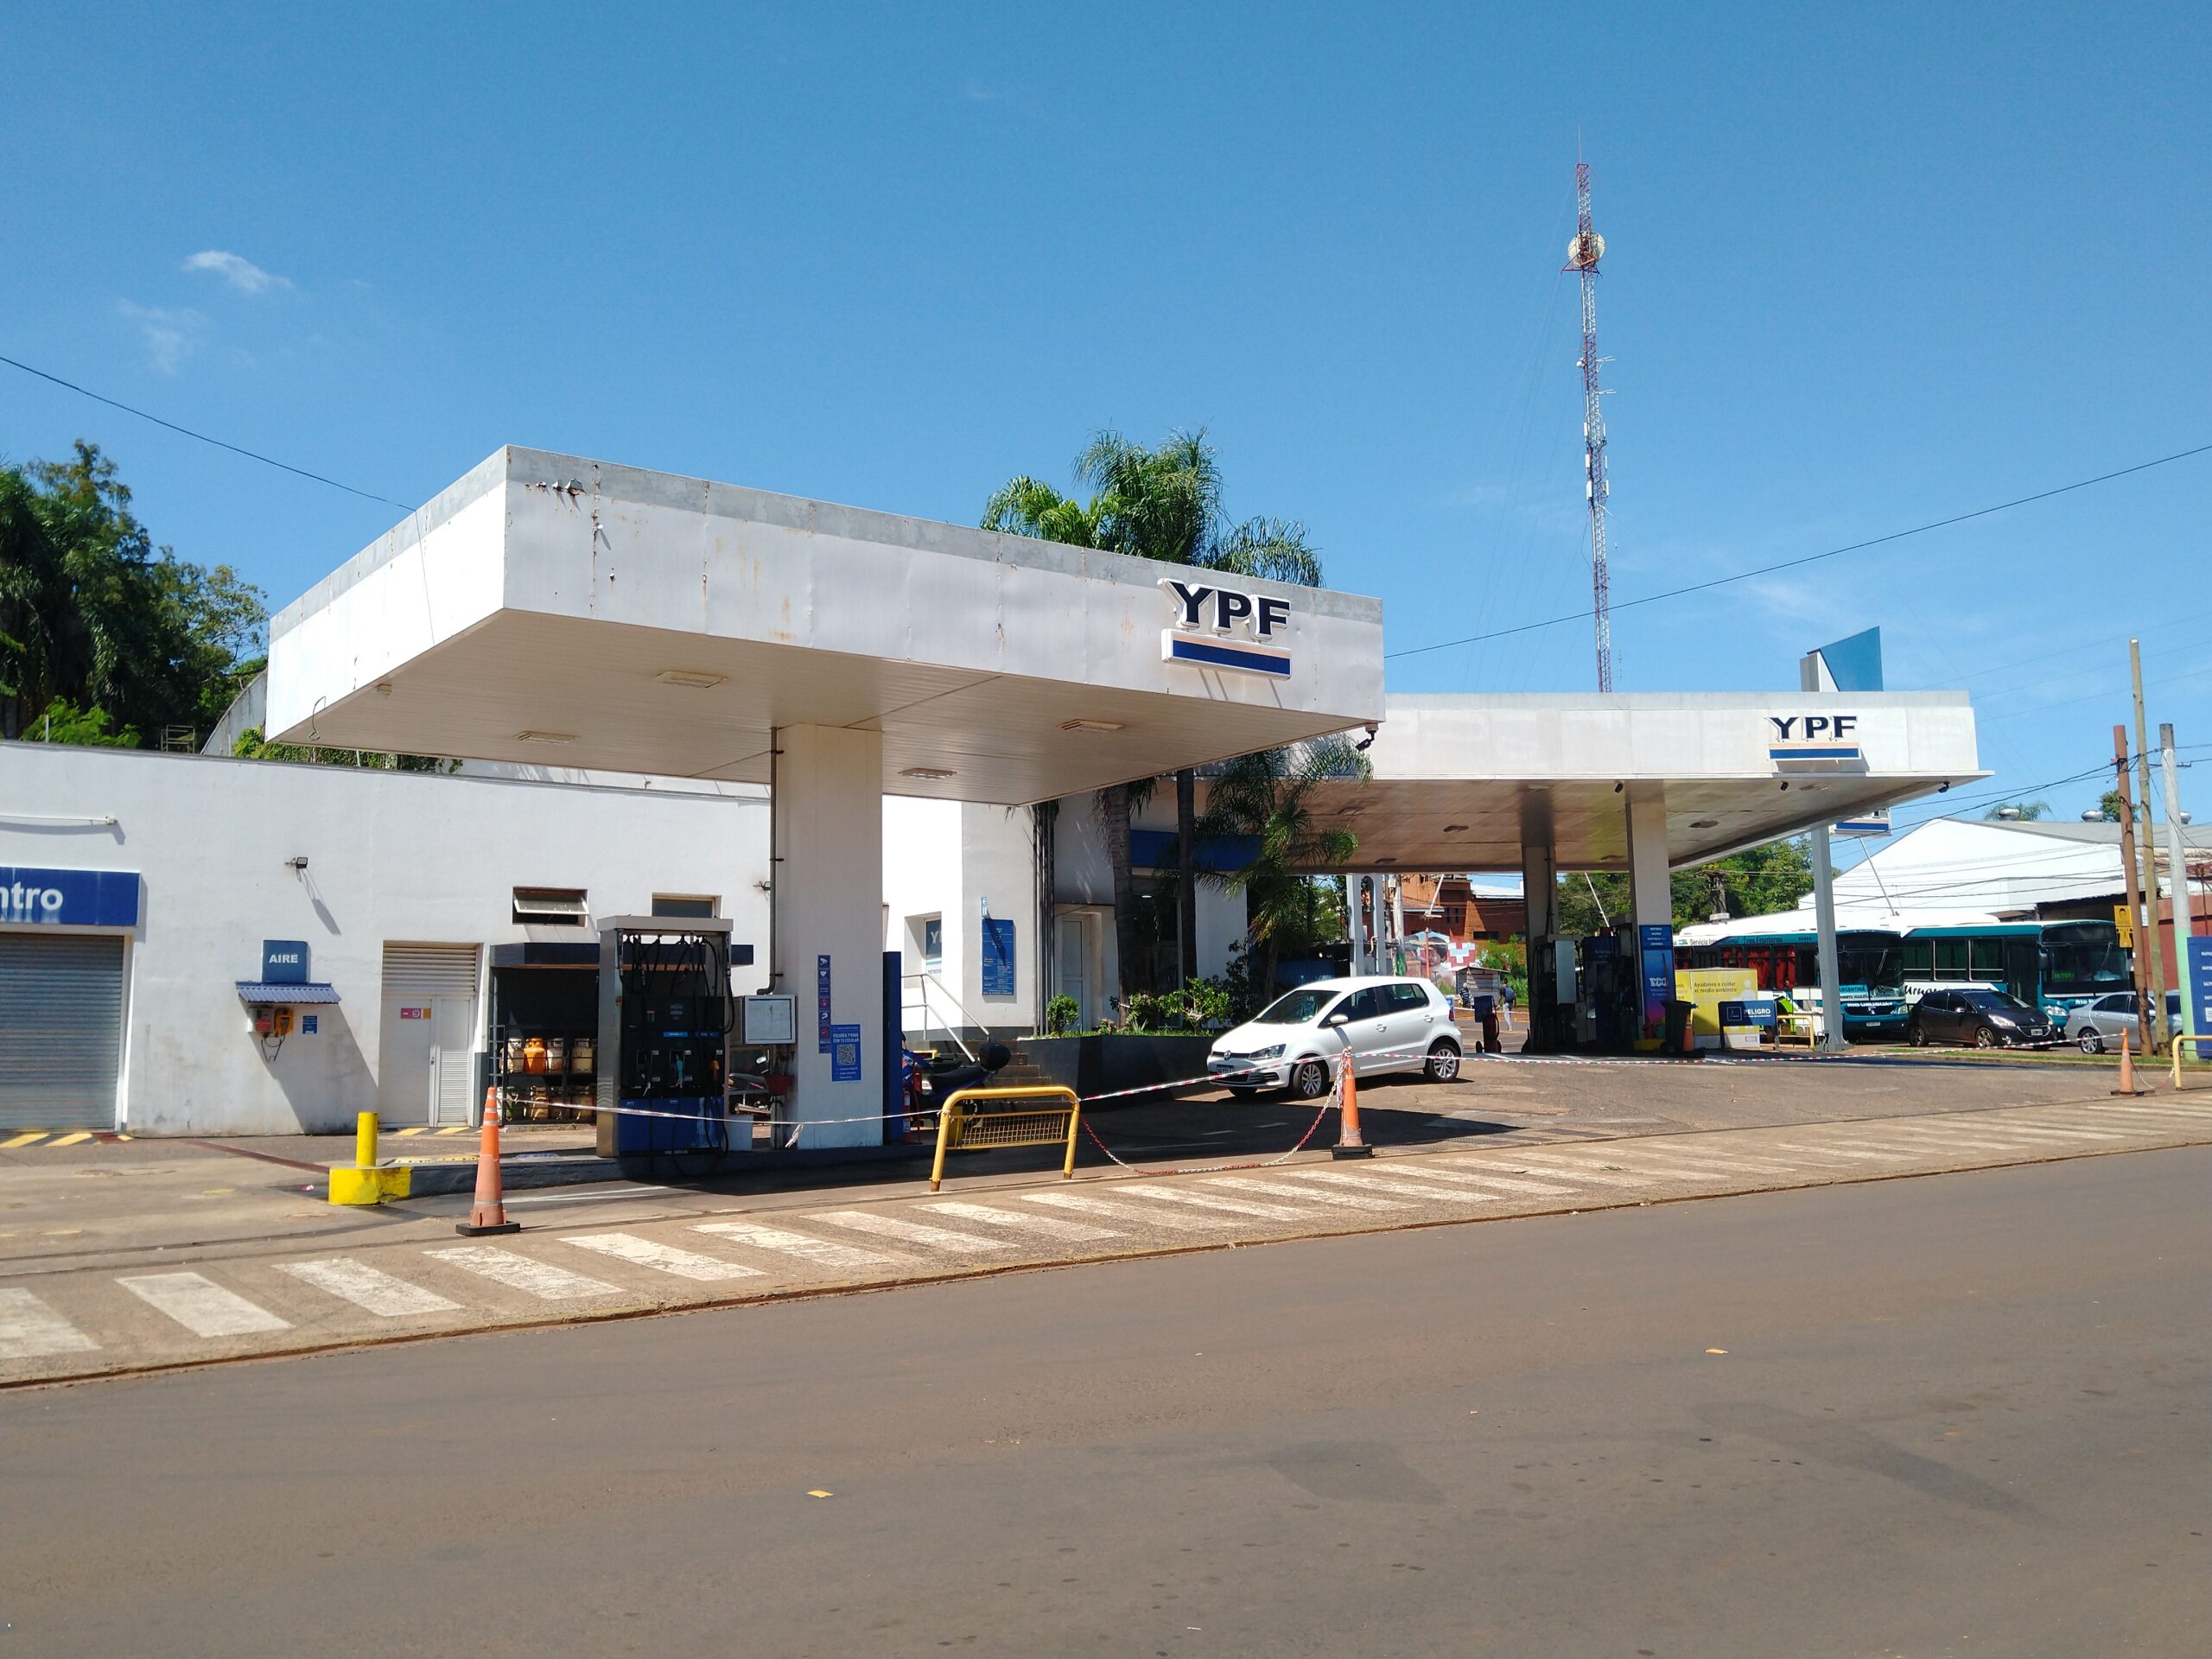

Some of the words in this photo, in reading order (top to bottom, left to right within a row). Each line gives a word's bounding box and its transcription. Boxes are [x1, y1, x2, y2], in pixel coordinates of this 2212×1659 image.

[1162, 580, 1291, 638] YPF
[1768, 715, 1857, 739] YPF
[269, 954, 298, 963] AIRE
